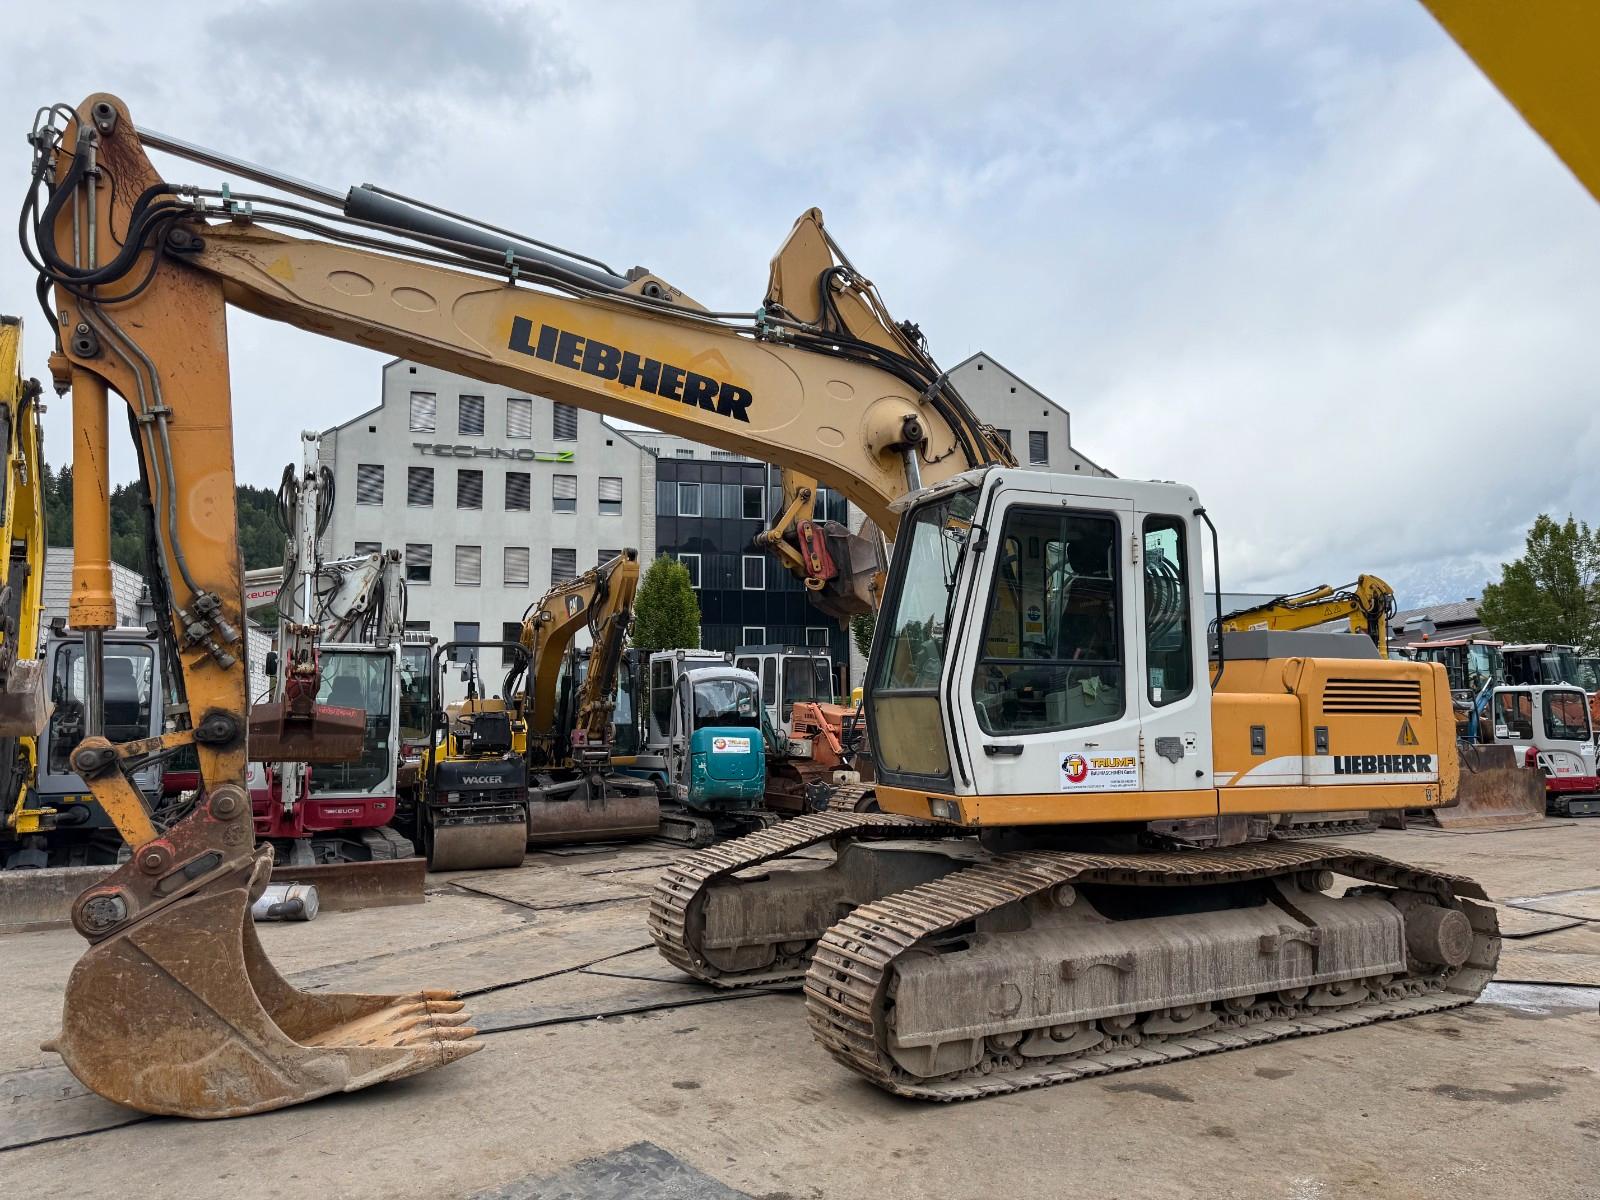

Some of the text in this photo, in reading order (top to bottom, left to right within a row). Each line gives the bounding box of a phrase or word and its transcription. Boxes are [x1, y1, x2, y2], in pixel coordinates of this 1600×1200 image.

[508, 315, 753, 424] LIEBHERR
[1333, 754, 1432, 775] LIEBHERR
[462, 775, 503, 785] WACKER
